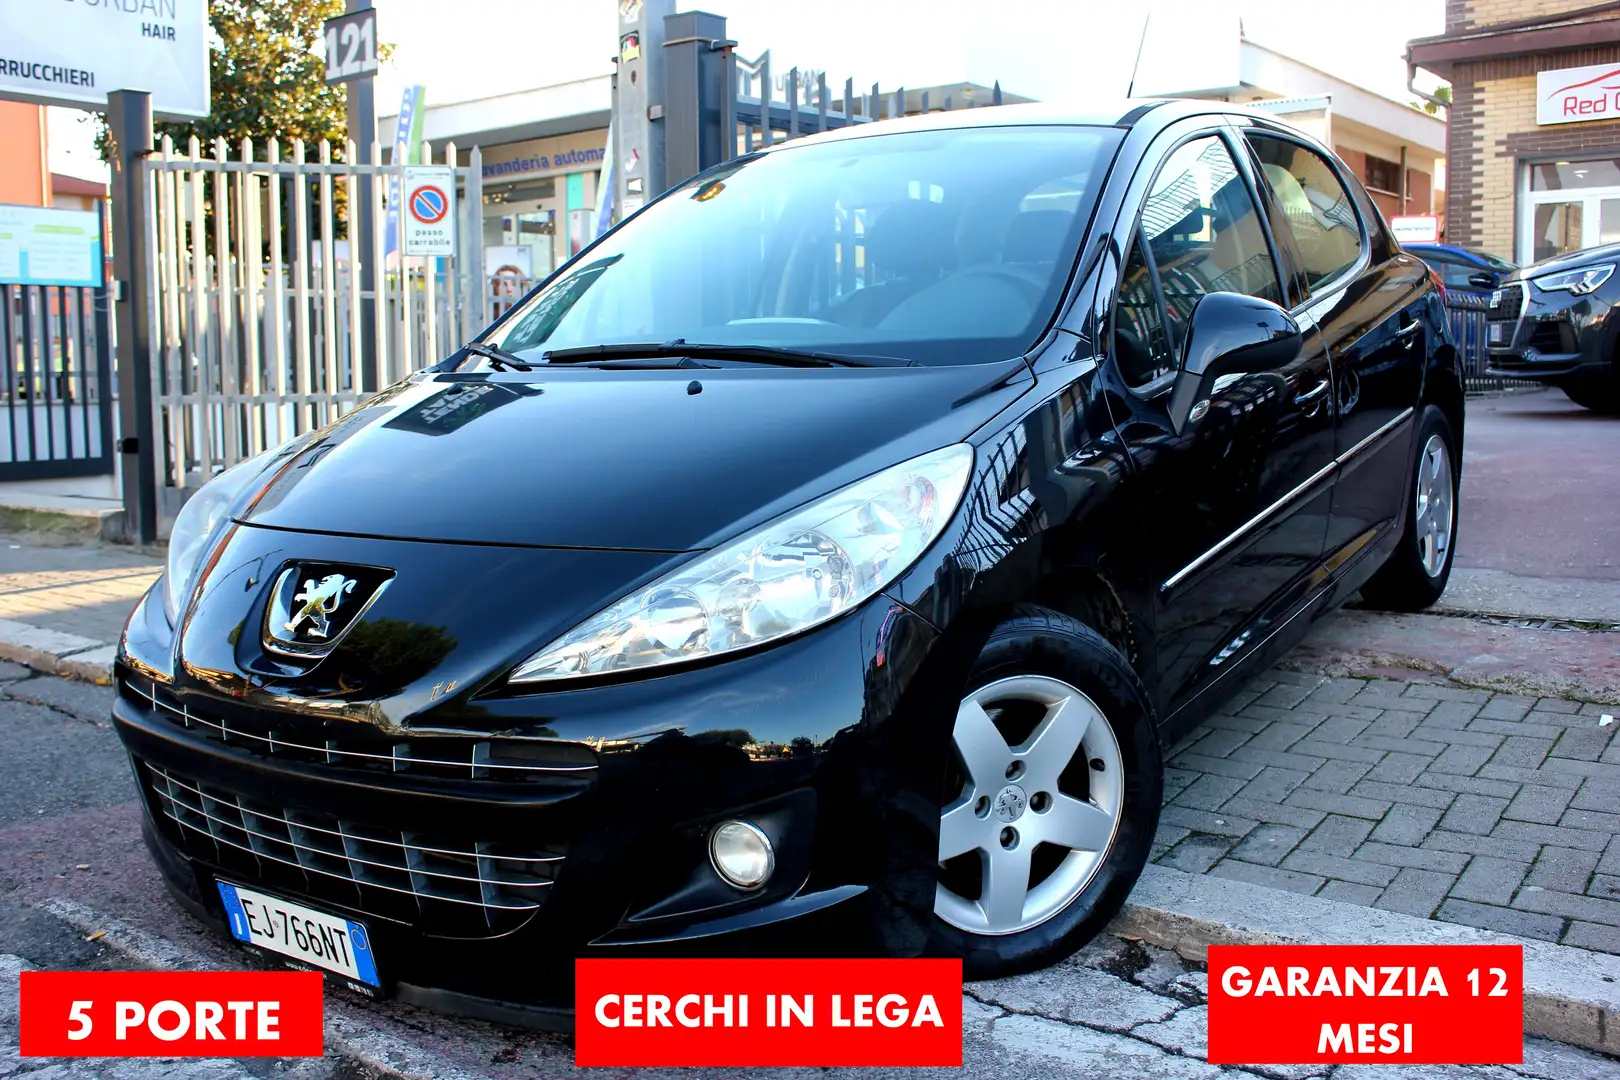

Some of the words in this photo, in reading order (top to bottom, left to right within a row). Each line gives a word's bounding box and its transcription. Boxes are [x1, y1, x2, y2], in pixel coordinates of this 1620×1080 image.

[142, 22, 176, 42] HAIR
[326, 17, 377, 80] 121
[0, 58, 95, 88] RRUCCHIERI
[1563, 93, 1607, 116] Red
[409, 237, 451, 247] carrabile
[415, 229, 443, 237] passo
